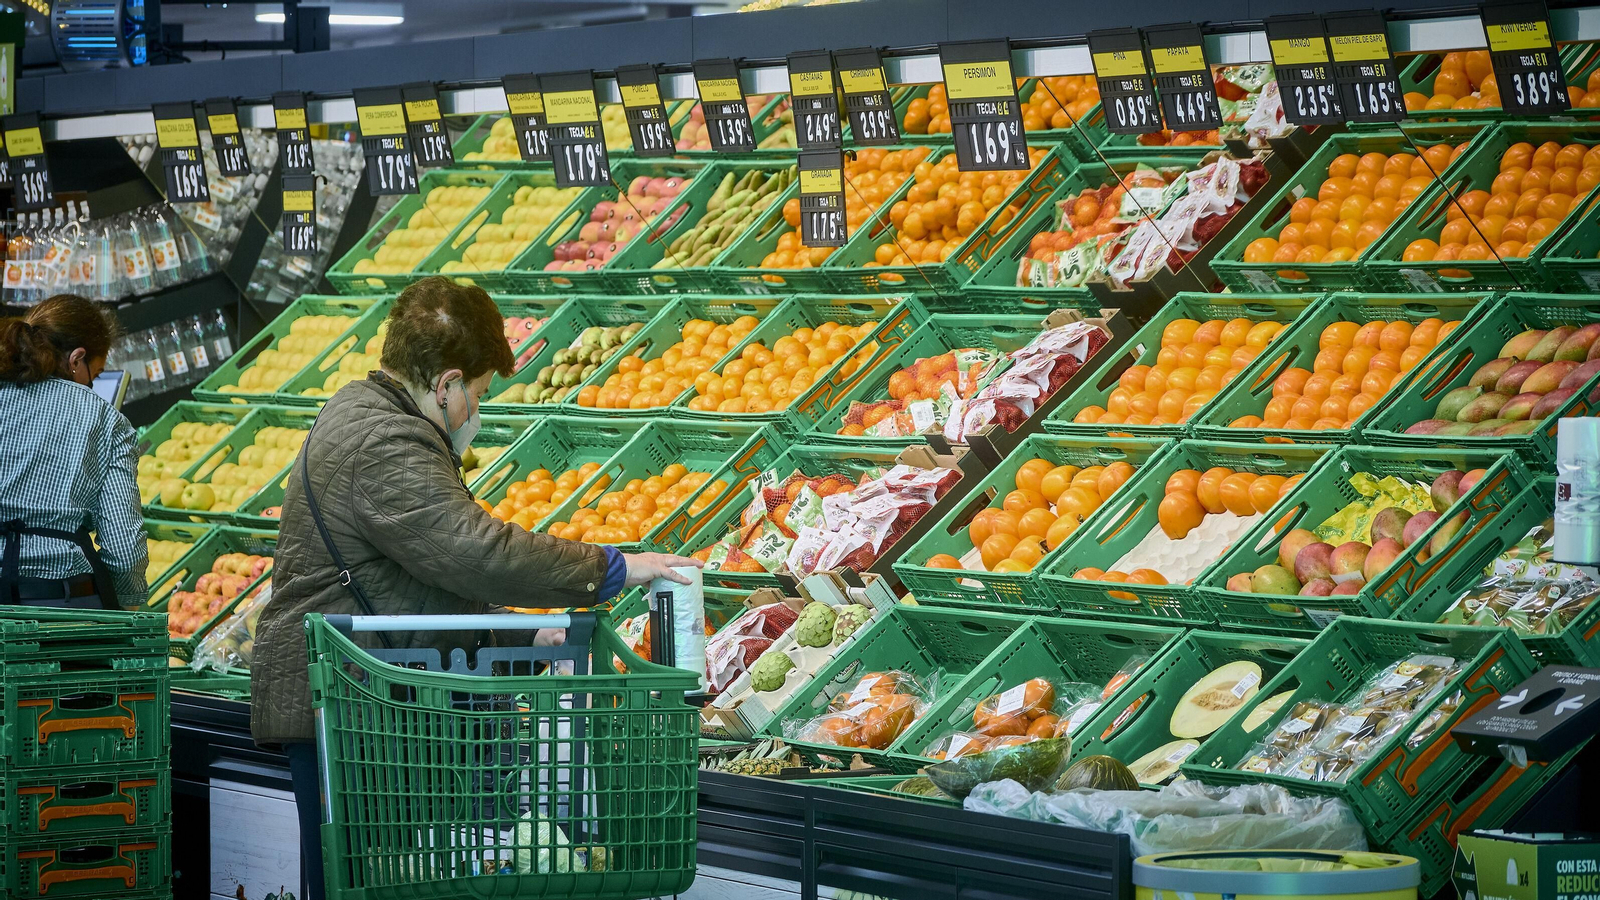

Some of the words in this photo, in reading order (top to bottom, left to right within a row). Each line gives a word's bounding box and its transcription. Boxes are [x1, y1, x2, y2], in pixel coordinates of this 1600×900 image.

[1520, 56, 1535, 66] TECLA
[963, 66, 997, 80] PERSIMON
[976, 102, 997, 114] TECLA
[568, 126, 584, 138] TECLA
[382, 138, 396, 149] TECLA
[1556, 860, 1574, 873] CON
[1576, 860, 1598, 873] ESTA
[1520, 871, 1530, 887] x4
